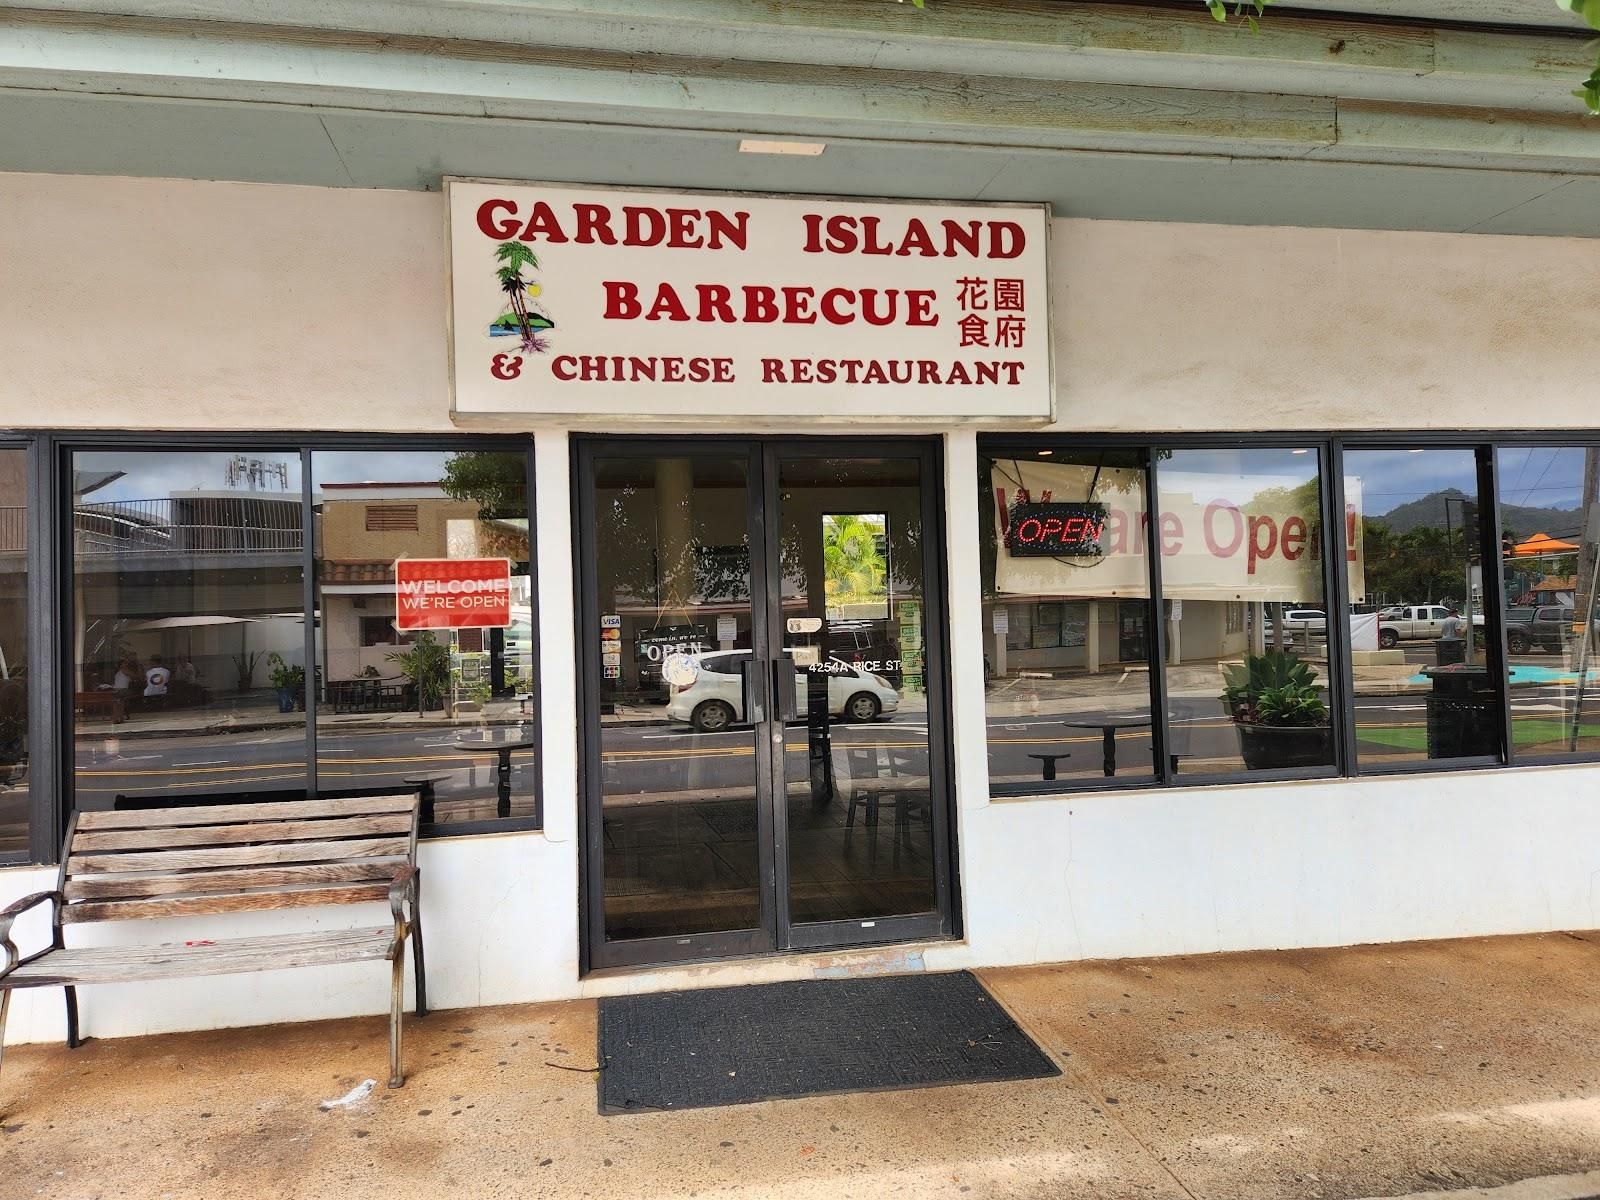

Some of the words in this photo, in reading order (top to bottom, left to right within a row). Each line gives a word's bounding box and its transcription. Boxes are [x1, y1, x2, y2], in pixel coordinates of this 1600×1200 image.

[476, 198, 750, 251] GARDEN
[803, 214, 1026, 259] ISLAND
[602, 281, 940, 327] BARBECUE
[955, 276, 1026, 313] 花園
[957, 313, 1026, 349] 食府
[490, 353, 524, 381] &
[551, 355, 736, 383] CHINESE
[761, 358, 1025, 386] RESTAURANT
[1018, 518, 1105, 543] OPEN
[400, 579, 506, 595] WELCOME
[402, 596, 456, 609] WE'RE
[460, 595, 505, 608] OPEN
[647, 641, 702, 662] OPEN
[808, 661, 849, 673] 4254A
[853, 660, 881, 672] RICE
